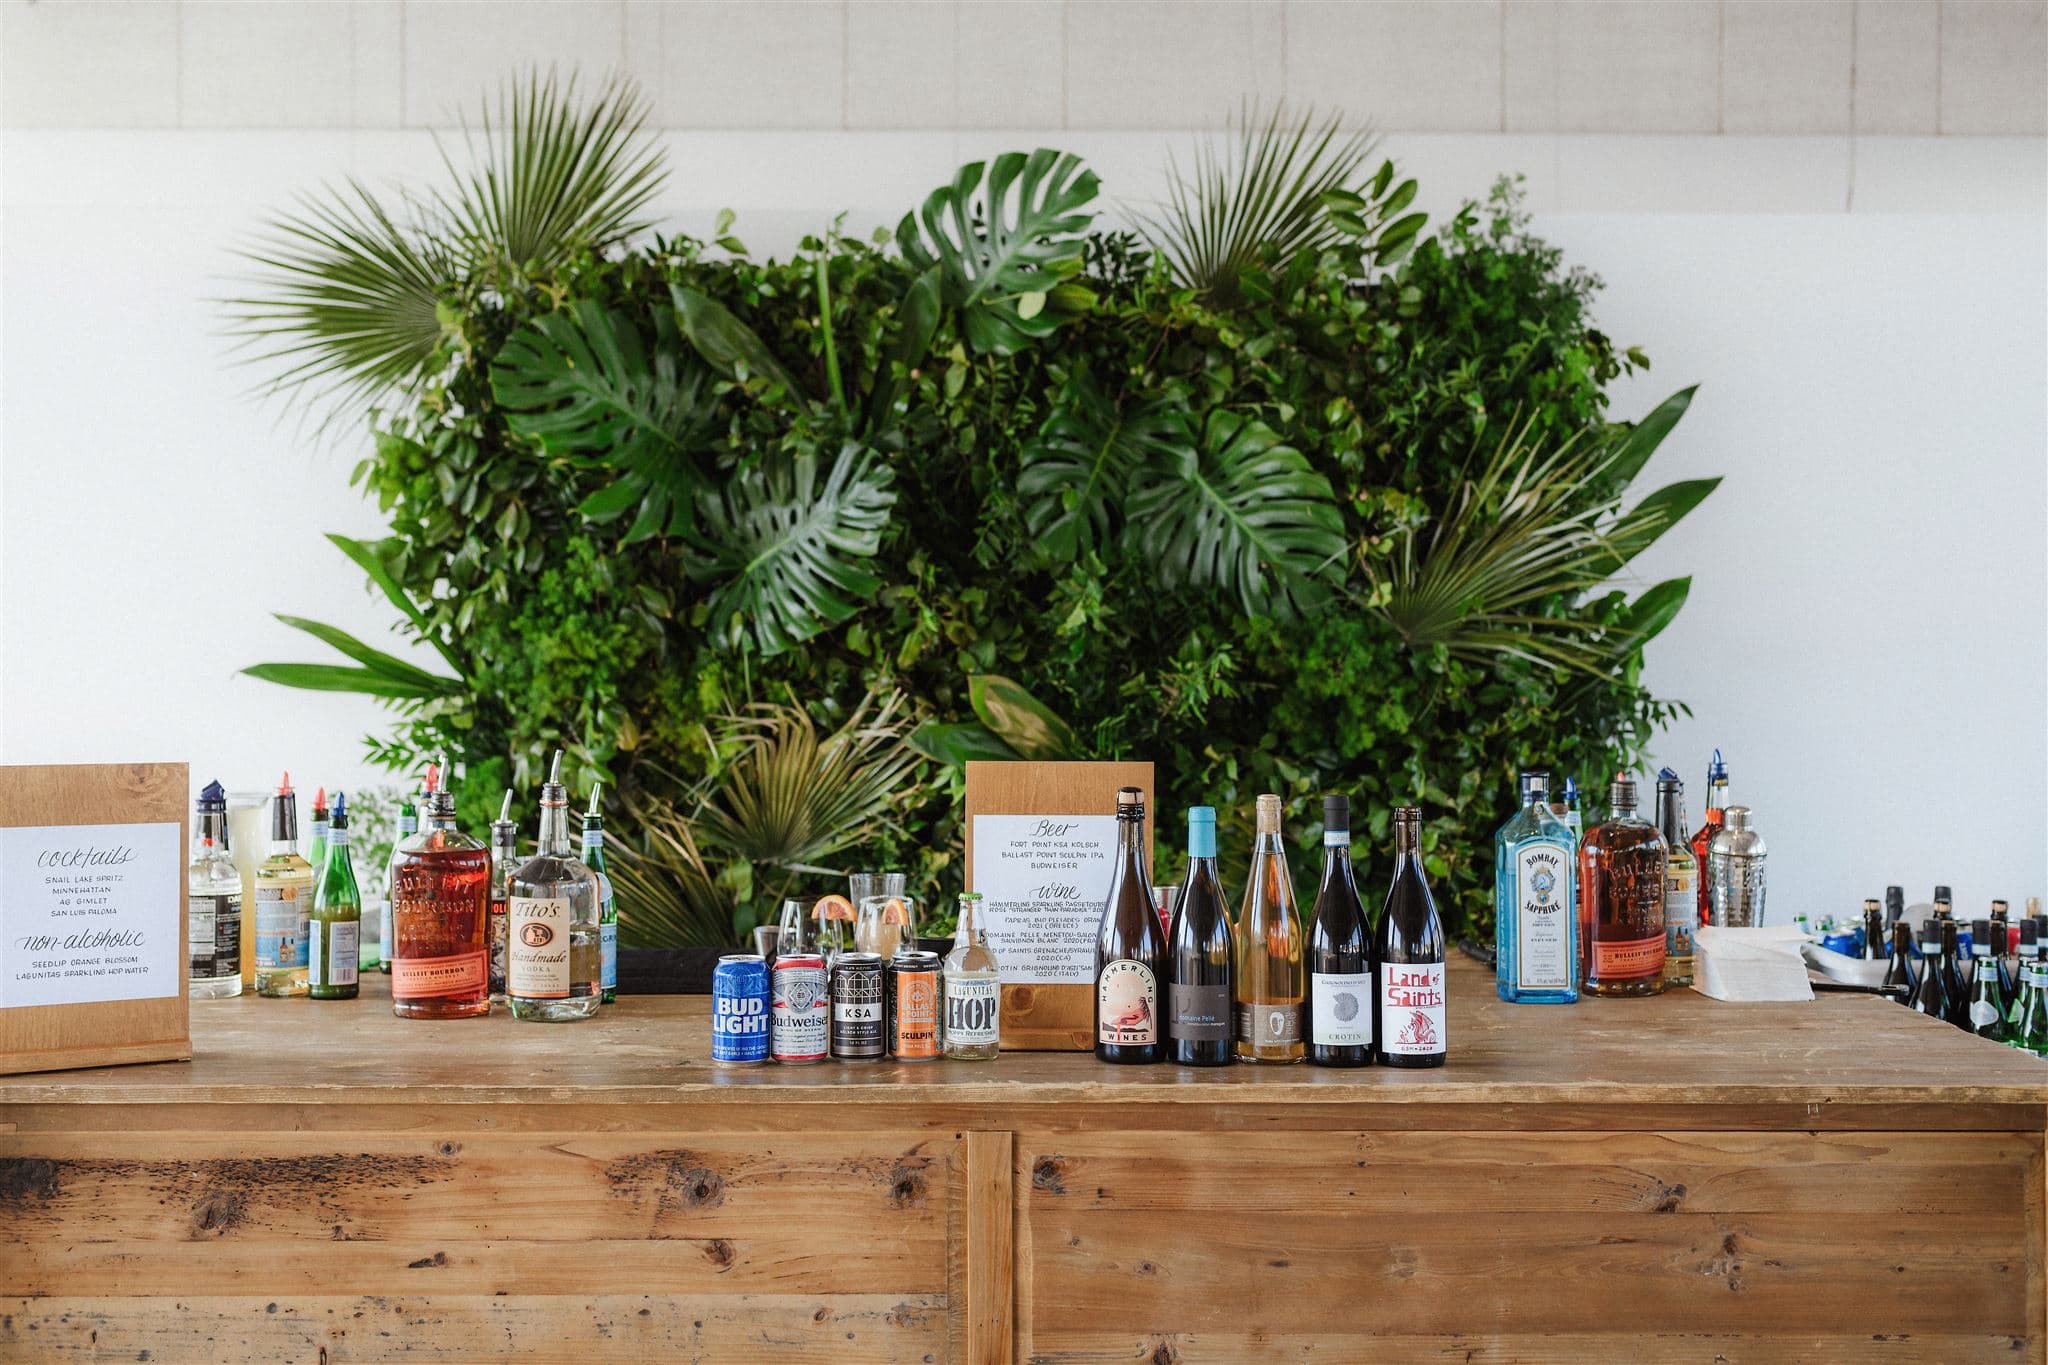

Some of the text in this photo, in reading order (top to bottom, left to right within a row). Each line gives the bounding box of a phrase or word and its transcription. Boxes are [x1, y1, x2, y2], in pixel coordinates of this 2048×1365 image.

[1029, 819, 1079, 837] Beer
[1032, 841, 1052, 849] POINT
[1053, 841, 1068, 849] KSA
[38, 846, 138, 868] cocktails
[1001, 852, 1033, 860] BALLAST
[1525, 853, 1561, 869] BOMBAY
[45, 876, 70, 885] SNAIL
[76, 897, 108, 905] GIMLET
[1524, 900, 1562, 915] SAPPHIRE
[516, 902, 560, 918] Tito's
[15, 928, 145, 951] non-alcoholic
[32, 956, 138, 968] SEEDLIP ORANGE BLOSSOM
[512, 949, 567, 963] Handmade
[16, 971, 61, 980] LAGUNITAS
[64, 968, 106, 977] SPARKLING
[108, 967, 123, 975] HOP
[430, 967, 465, 976] BOURBON
[1387, 967, 1431, 987] Land
[954, 985, 993, 996] LAGUNITAS
[1101, 964, 1154, 1004] HAMMERLING
[1387, 988, 1443, 1007] Saints
[718, 998, 763, 1016] BUD
[845, 1008, 871, 1018] KSA
[948, 997, 996, 1031] HOP
[713, 1014, 769, 1034] LIGHT
[901, 1032, 933, 1040] SCULPIN
[1108, 1034, 1147, 1042] WINES
